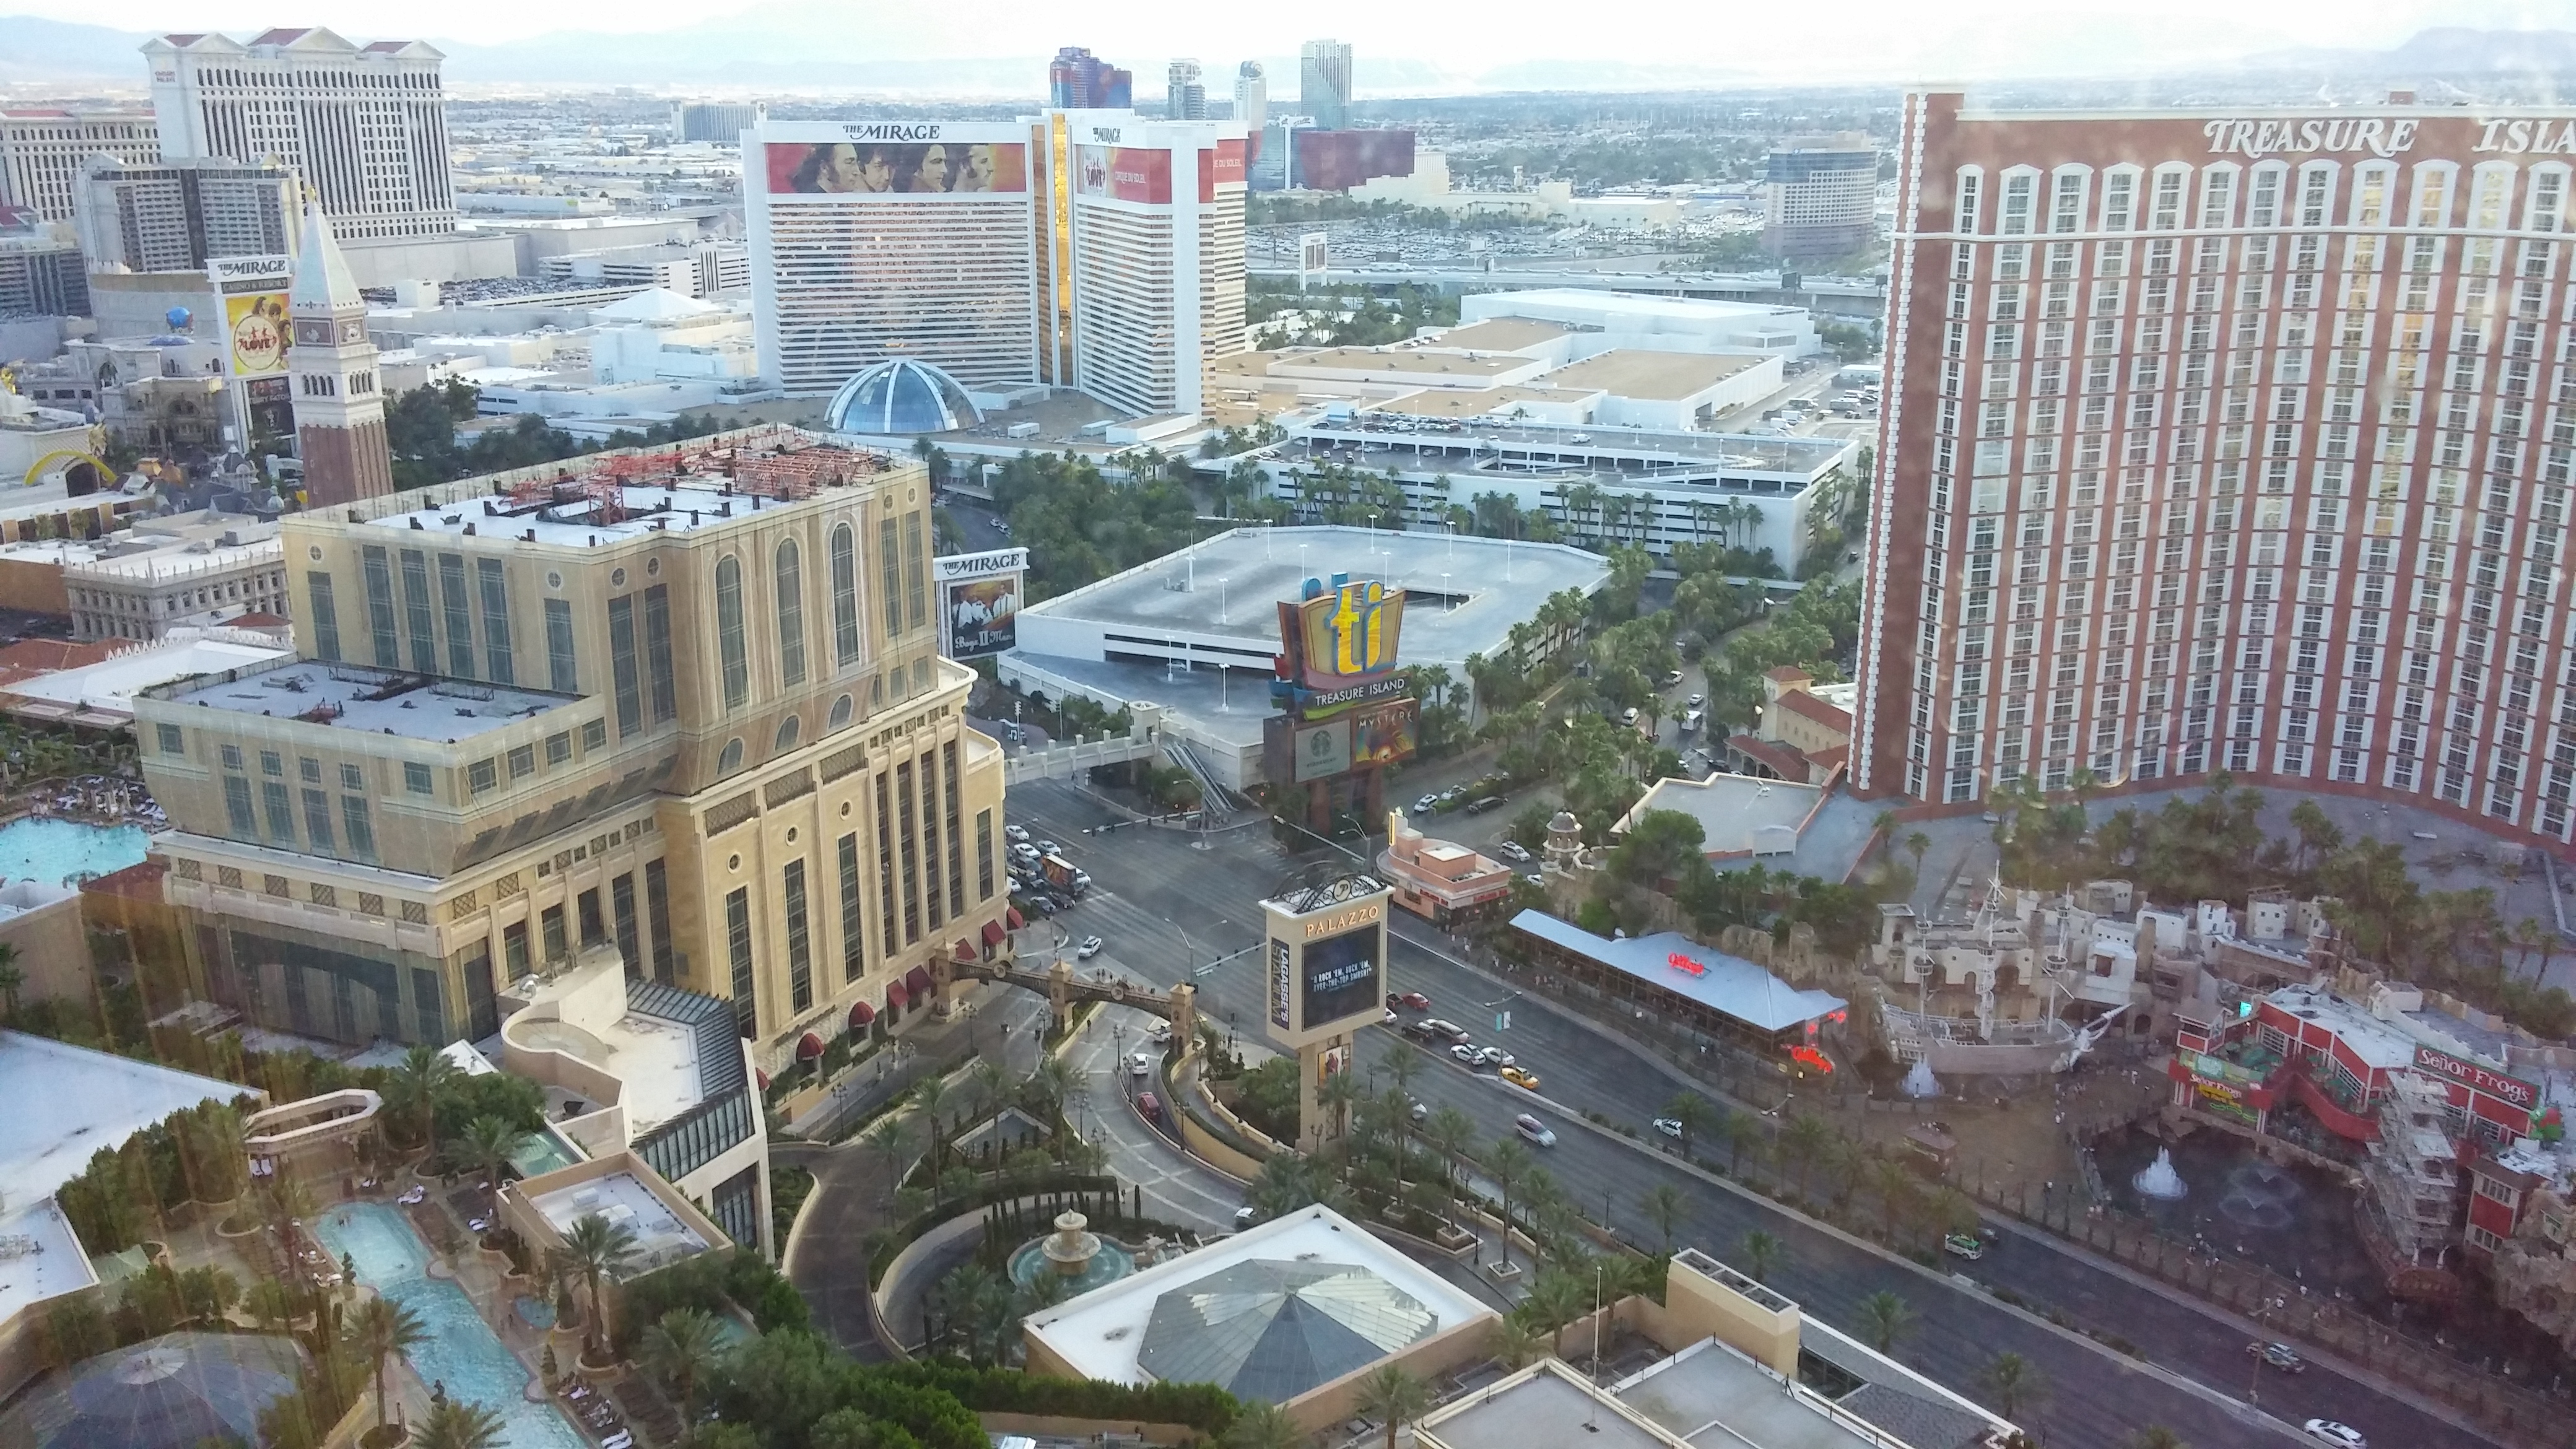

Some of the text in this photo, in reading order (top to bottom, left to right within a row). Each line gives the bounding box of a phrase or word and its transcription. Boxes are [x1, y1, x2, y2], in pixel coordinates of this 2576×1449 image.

[843, 125, 940, 141] THE MIRAGE
[1094, 128, 1120, 144] MIRAGE
[2203, 118, 2420, 159] TREASURE
[224, 260, 285, 276] MIRAGE
[943, 554, 1019, 575] THE MIRAGE
[978, 630, 989, 646] II
[1315, 678, 1405, 707] TREASURE ISLAND
[1306, 905, 1378, 938] PALAZZO
[1271, 943, 1281, 1019] STADIUM
[1281, 947, 1289, 1022] LAGASSE'S
[1318, 971, 1332, 983] ROCK
[2419, 1049, 2472, 1077] Señor
